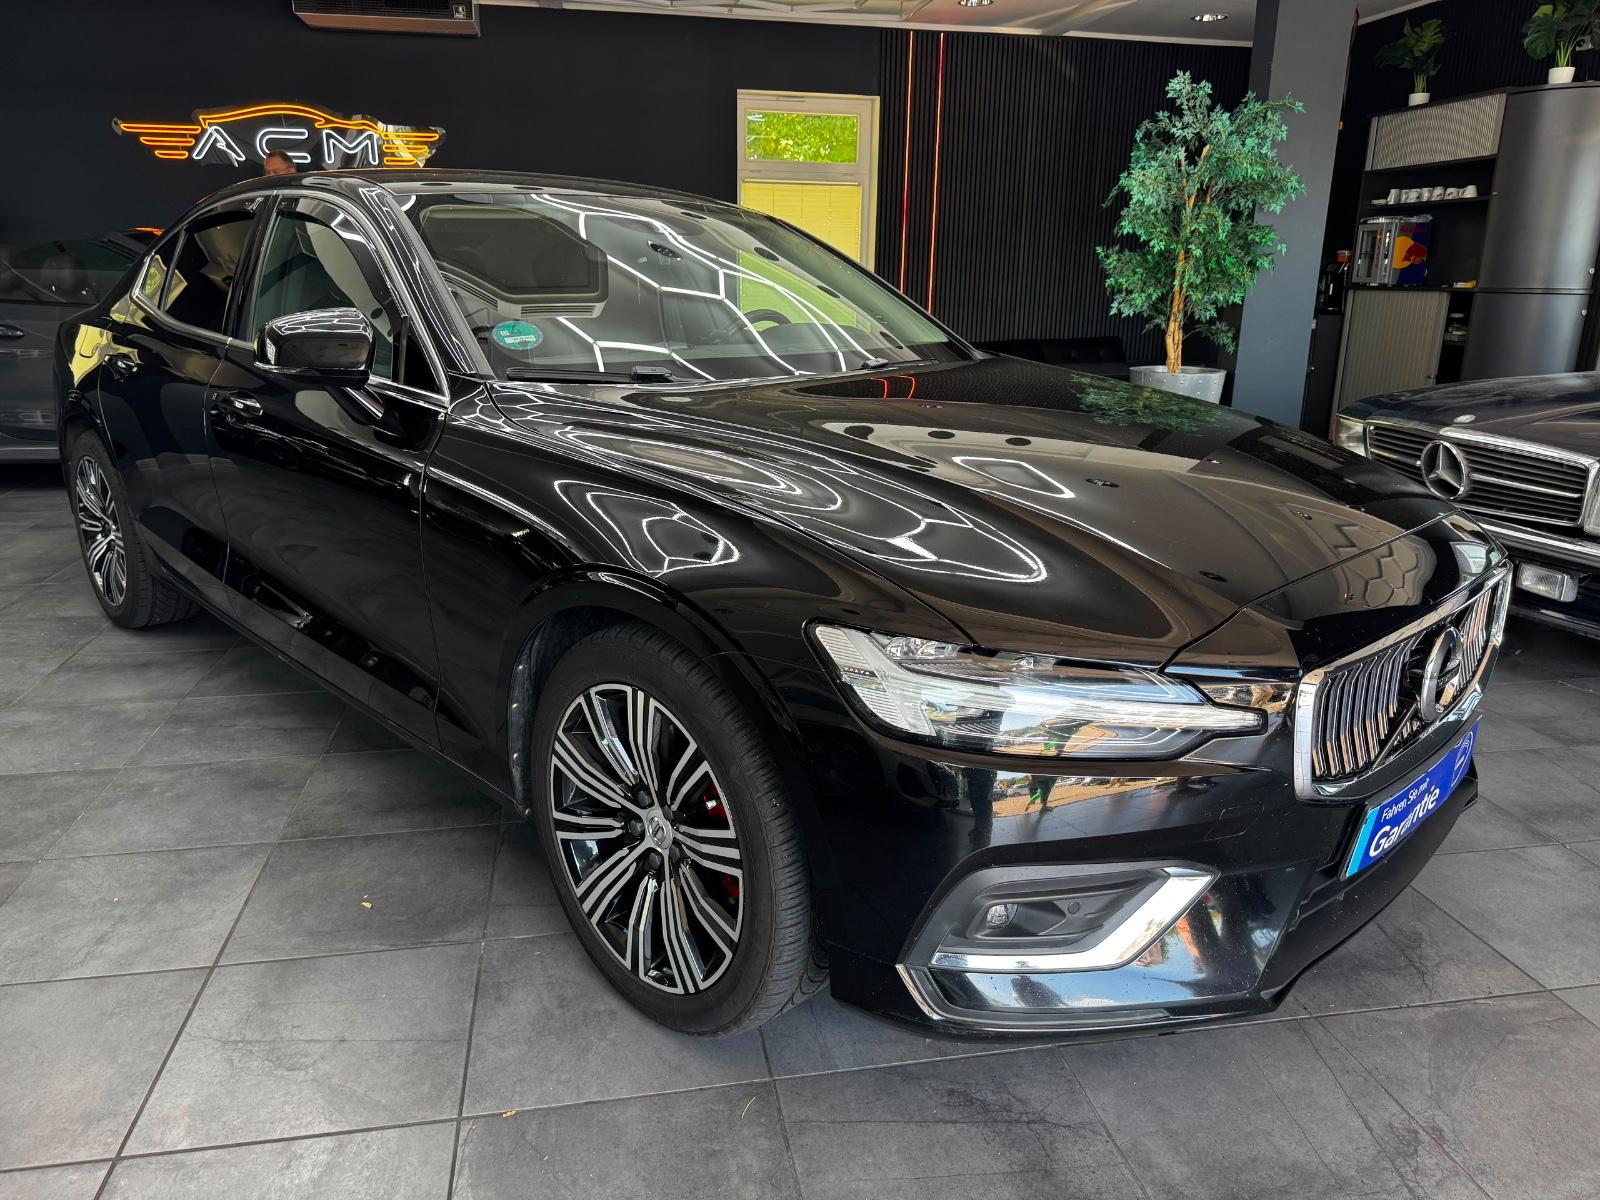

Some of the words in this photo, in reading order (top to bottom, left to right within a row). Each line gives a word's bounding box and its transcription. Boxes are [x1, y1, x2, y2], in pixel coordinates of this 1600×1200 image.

[192, 125, 379, 166] ACM
[1369, 785, 1440, 857] Garantie
[1381, 798, 1407, 823] Fahren
[1407, 788, 1418, 804] Sie
